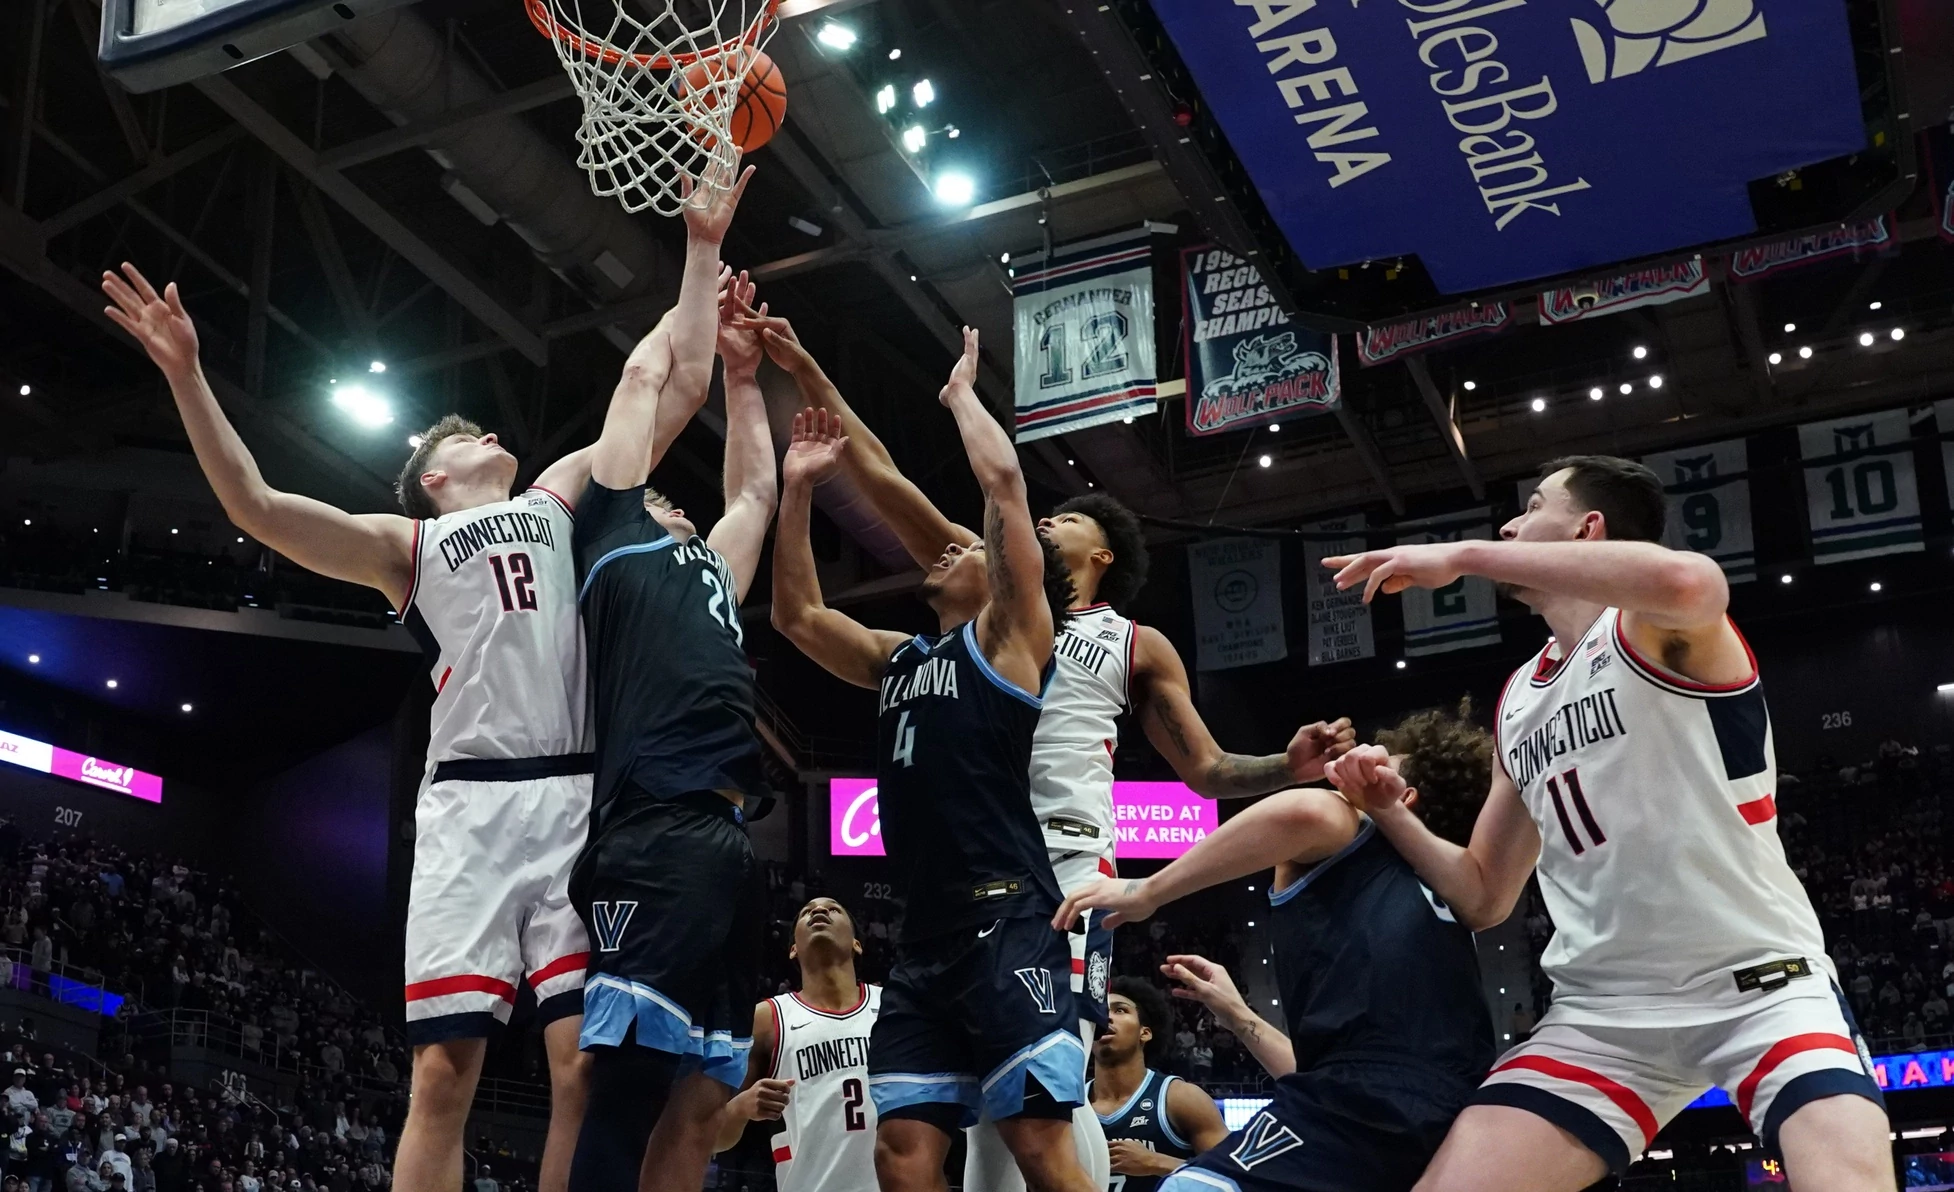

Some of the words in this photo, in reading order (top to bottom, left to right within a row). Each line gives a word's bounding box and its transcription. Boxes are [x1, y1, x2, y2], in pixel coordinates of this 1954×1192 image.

[1234, 0, 1392, 189] ARENA
[1193, 250, 1246, 274] 199
[1203, 265, 1264, 295] REGU
[1040, 310, 1128, 390] 12
[1199, 390, 1261, 427] WOLF
[1263, 370, 1328, 409] PACK
[1824, 459, 1897, 520] 10
[439, 512, 556, 573] CONNECTICUT
[1683, 493, 1721, 550] 9
[488, 552, 539, 612] 12
[1053, 631, 1110, 676] TICUT
[892, 709, 917, 768] 4
[1508, 688, 1627, 795] CONNECTICUT
[1821, 710, 1852, 731] 236
[54, 806, 83, 828] 207
[1144, 827, 1207, 843] ARENA
[1179, 805, 1202, 821] AT
[1546, 767, 1607, 856] 11
[863, 881, 892, 900] 232
[592, 901, 639, 952] V
[1014, 967, 1057, 1014] V
[1786, 963, 1800, 973] 50
[796, 1036, 871, 1080] CONNECTI
[842, 1078, 866, 1131] 2
[1230, 1111, 1304, 1171] V
